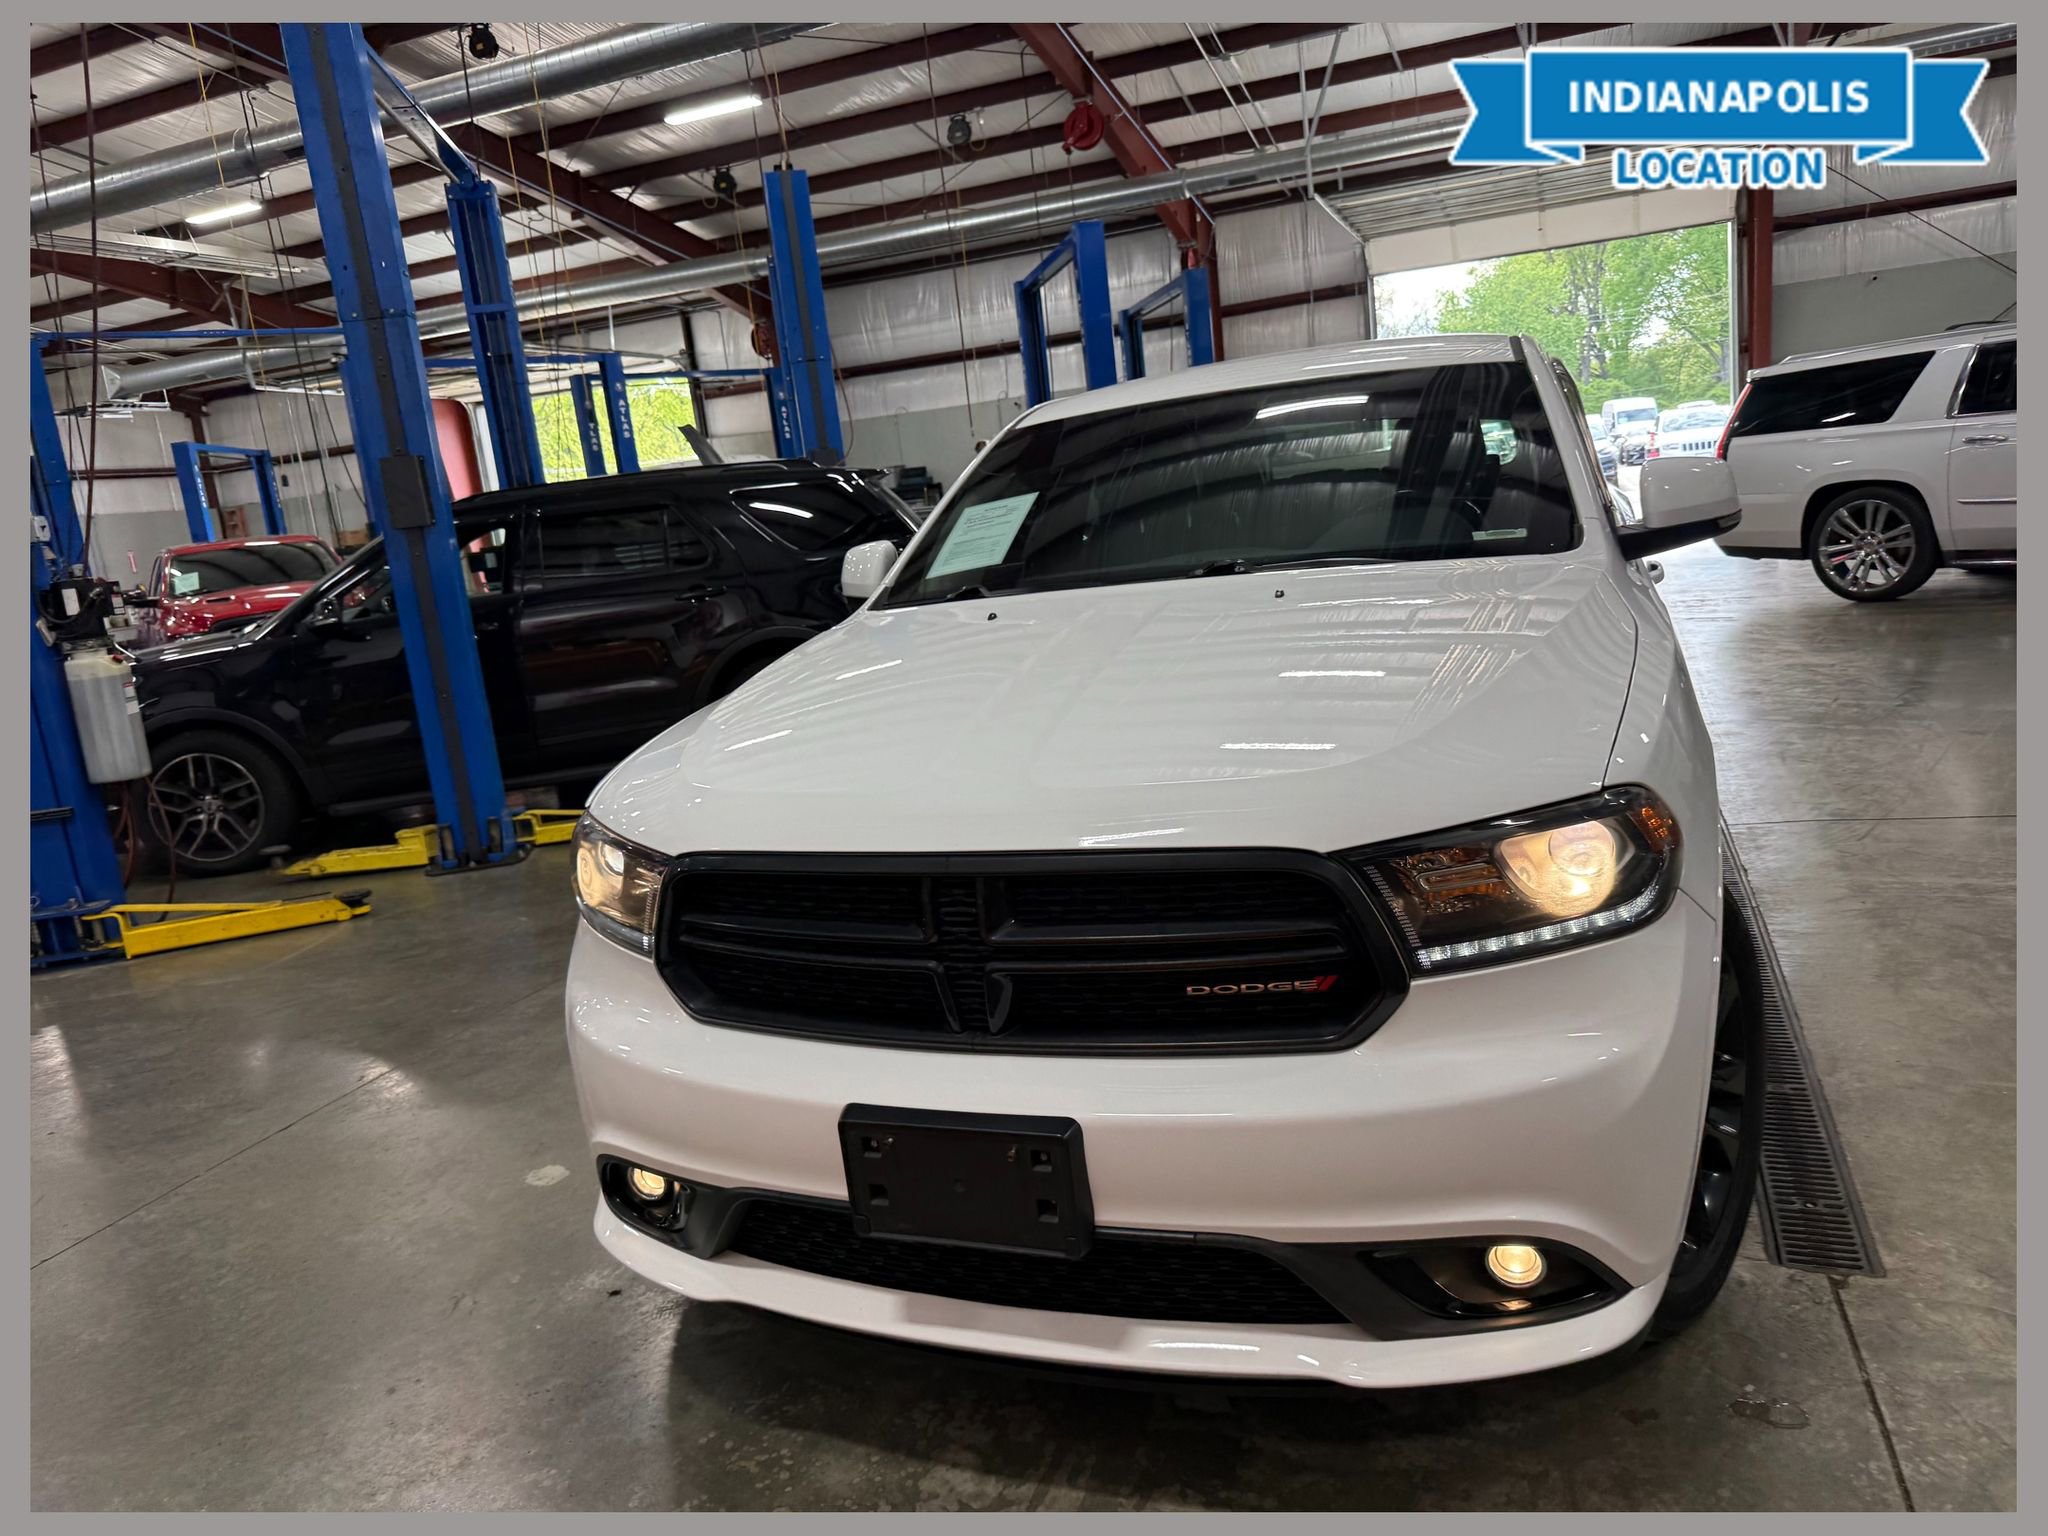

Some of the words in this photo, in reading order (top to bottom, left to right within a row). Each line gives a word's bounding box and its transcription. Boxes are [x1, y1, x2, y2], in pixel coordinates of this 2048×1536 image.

[618, 399, 631, 439] ATLAS
[780, 405, 792, 439] ATLAS
[1186, 979, 1318, 996] DODGE
